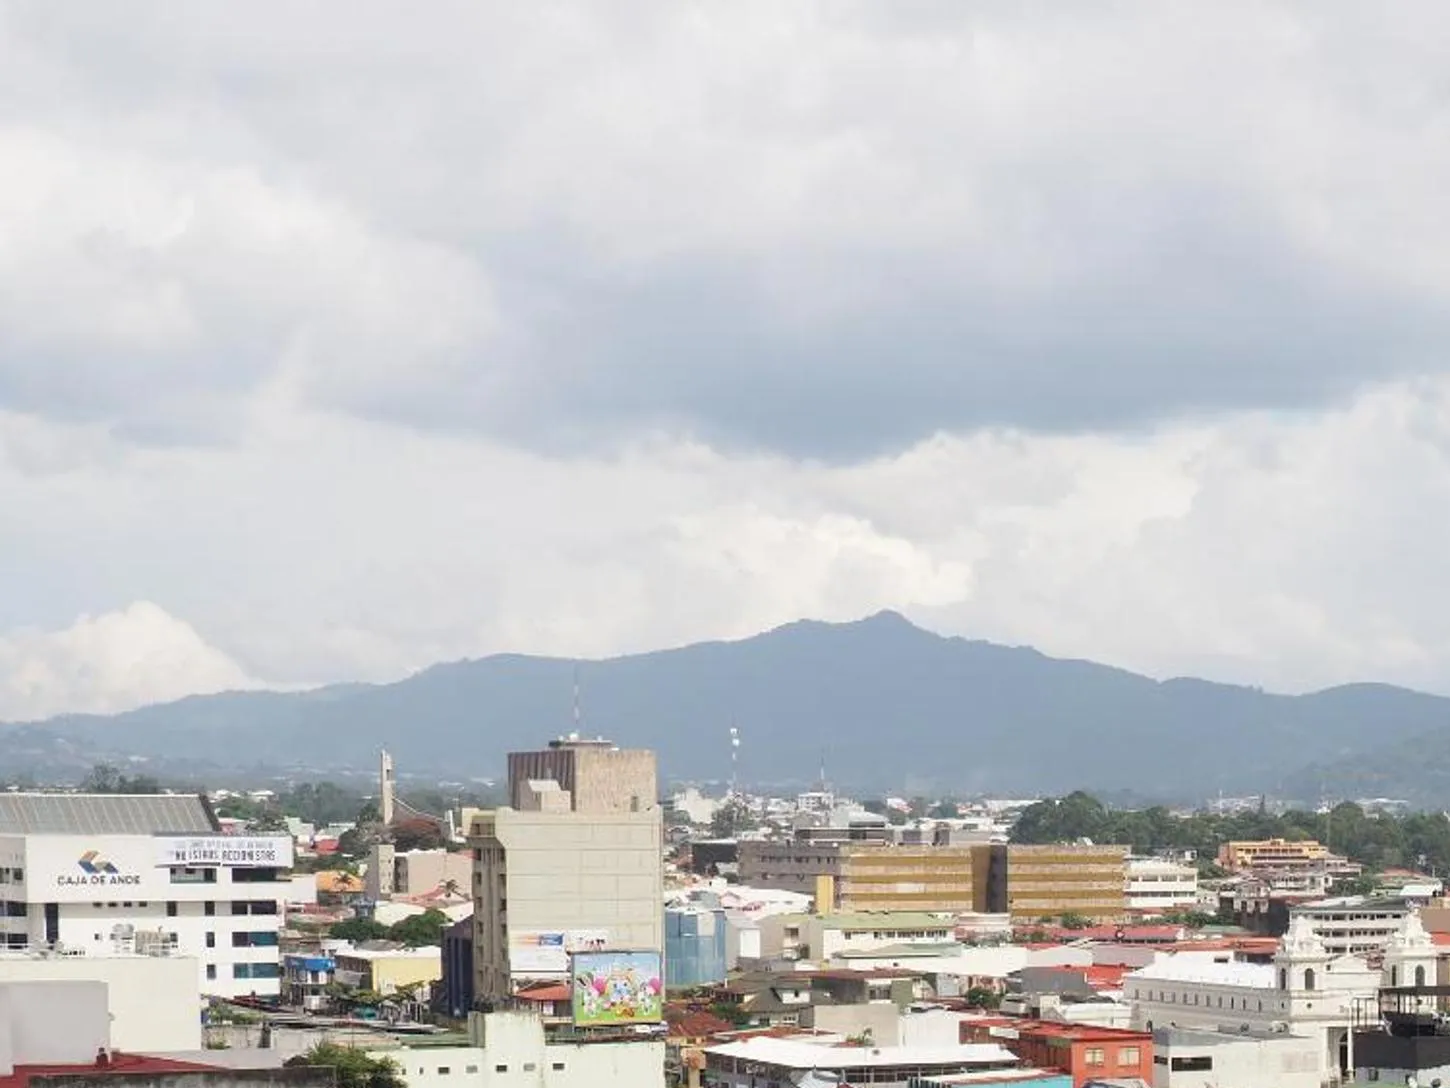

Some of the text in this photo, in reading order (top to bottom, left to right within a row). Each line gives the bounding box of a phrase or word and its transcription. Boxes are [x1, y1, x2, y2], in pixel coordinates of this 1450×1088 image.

[57, 875, 141, 886] CAJA DE ANDE
